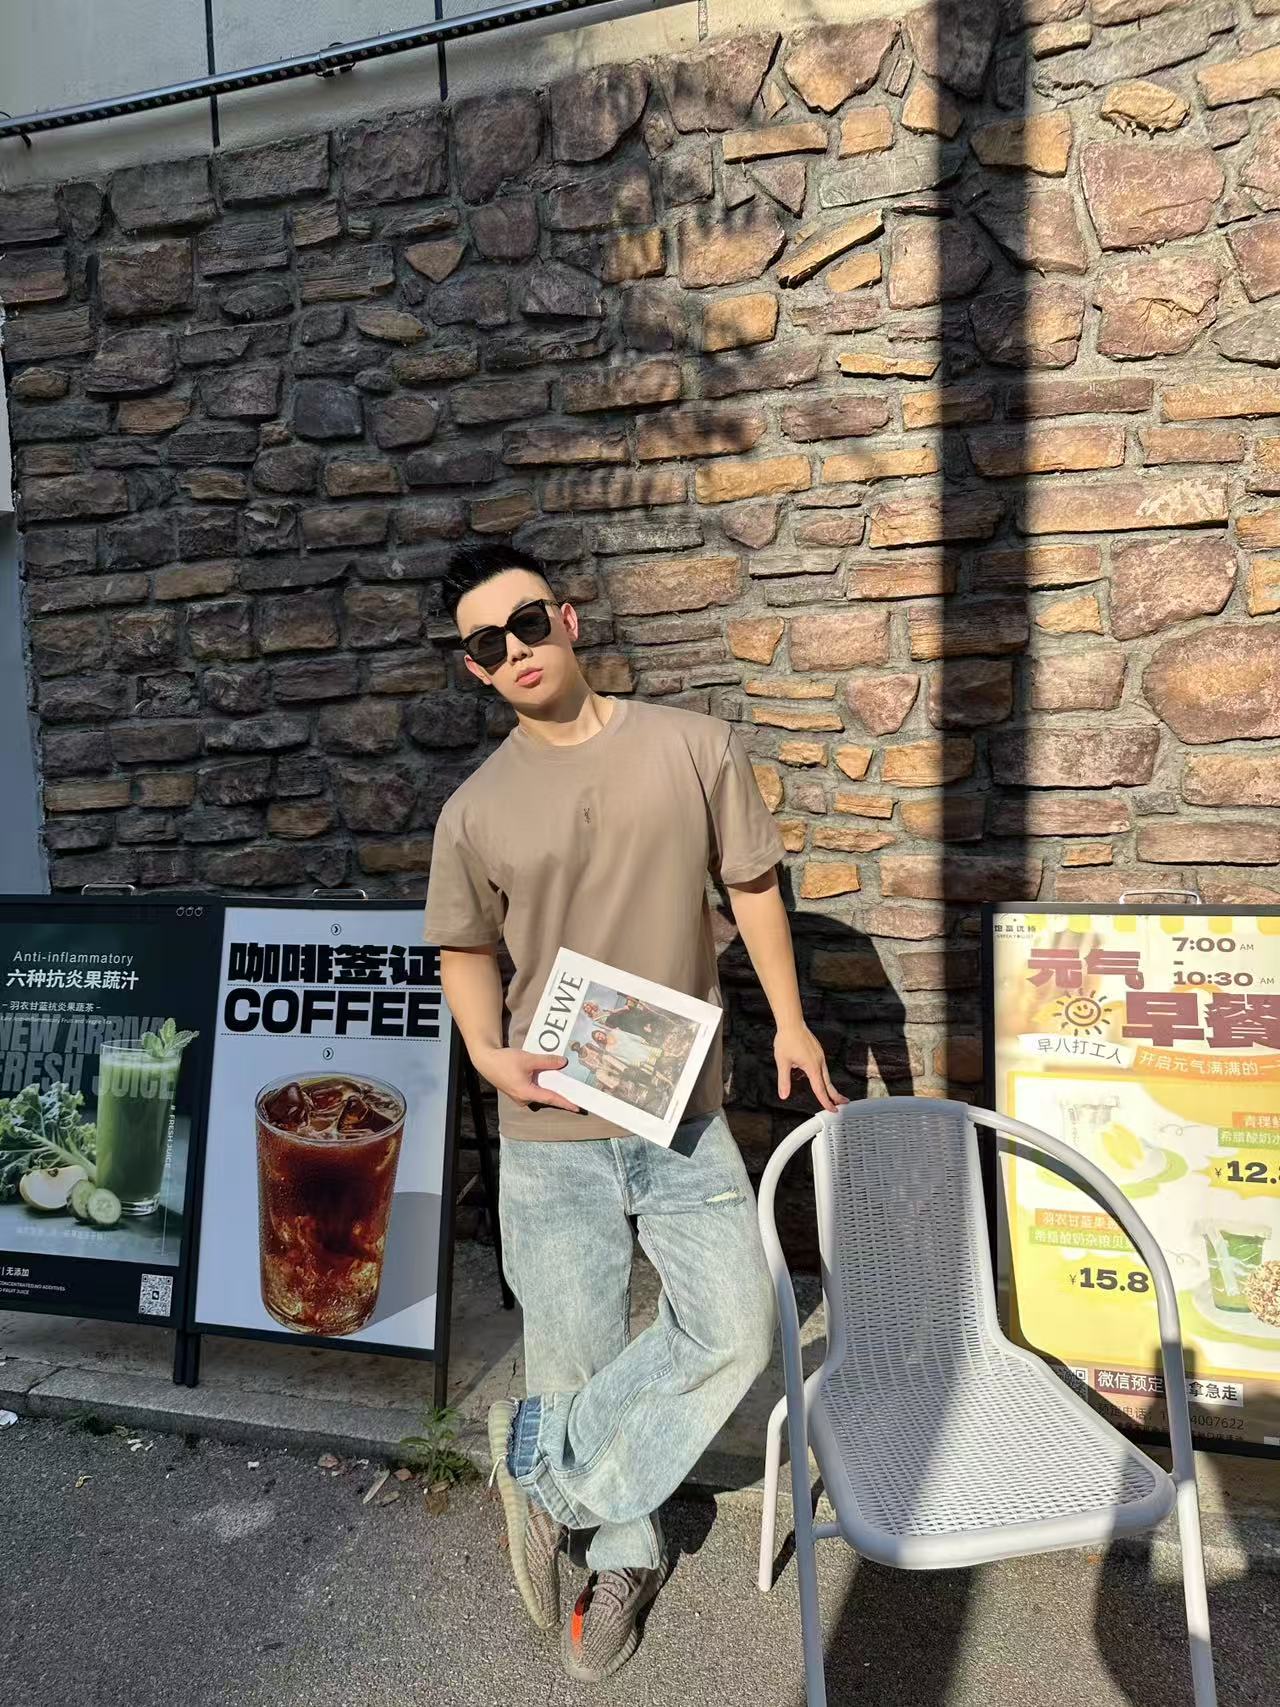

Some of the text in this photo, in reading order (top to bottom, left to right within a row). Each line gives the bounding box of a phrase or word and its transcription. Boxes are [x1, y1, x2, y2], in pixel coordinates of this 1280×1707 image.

[1172, 937, 1236, 952] 7:00
[13, 951, 134, 966] Anti-inflammatory
[228, 942, 441, 985] 咖啡签证
[1026, 948, 1144, 990] 元气
[6, 969, 139, 990] 六种抗炎果蔬汁
[1173, 971, 1253, 986] 10:30
[224, 987, 441, 1037] COFFEE
[539, 972, 583, 1052] OEWE
[1038, 1039, 1122, 1064] 早八打工人
[1140, 1050, 1280, 1075] 开启元气满满的一
[1215, 1161, 1280, 1185] ¥12.
[1098, 1371, 1164, 1393] 微信预定
[1188, 1381, 1238, 1401] 拿急走
